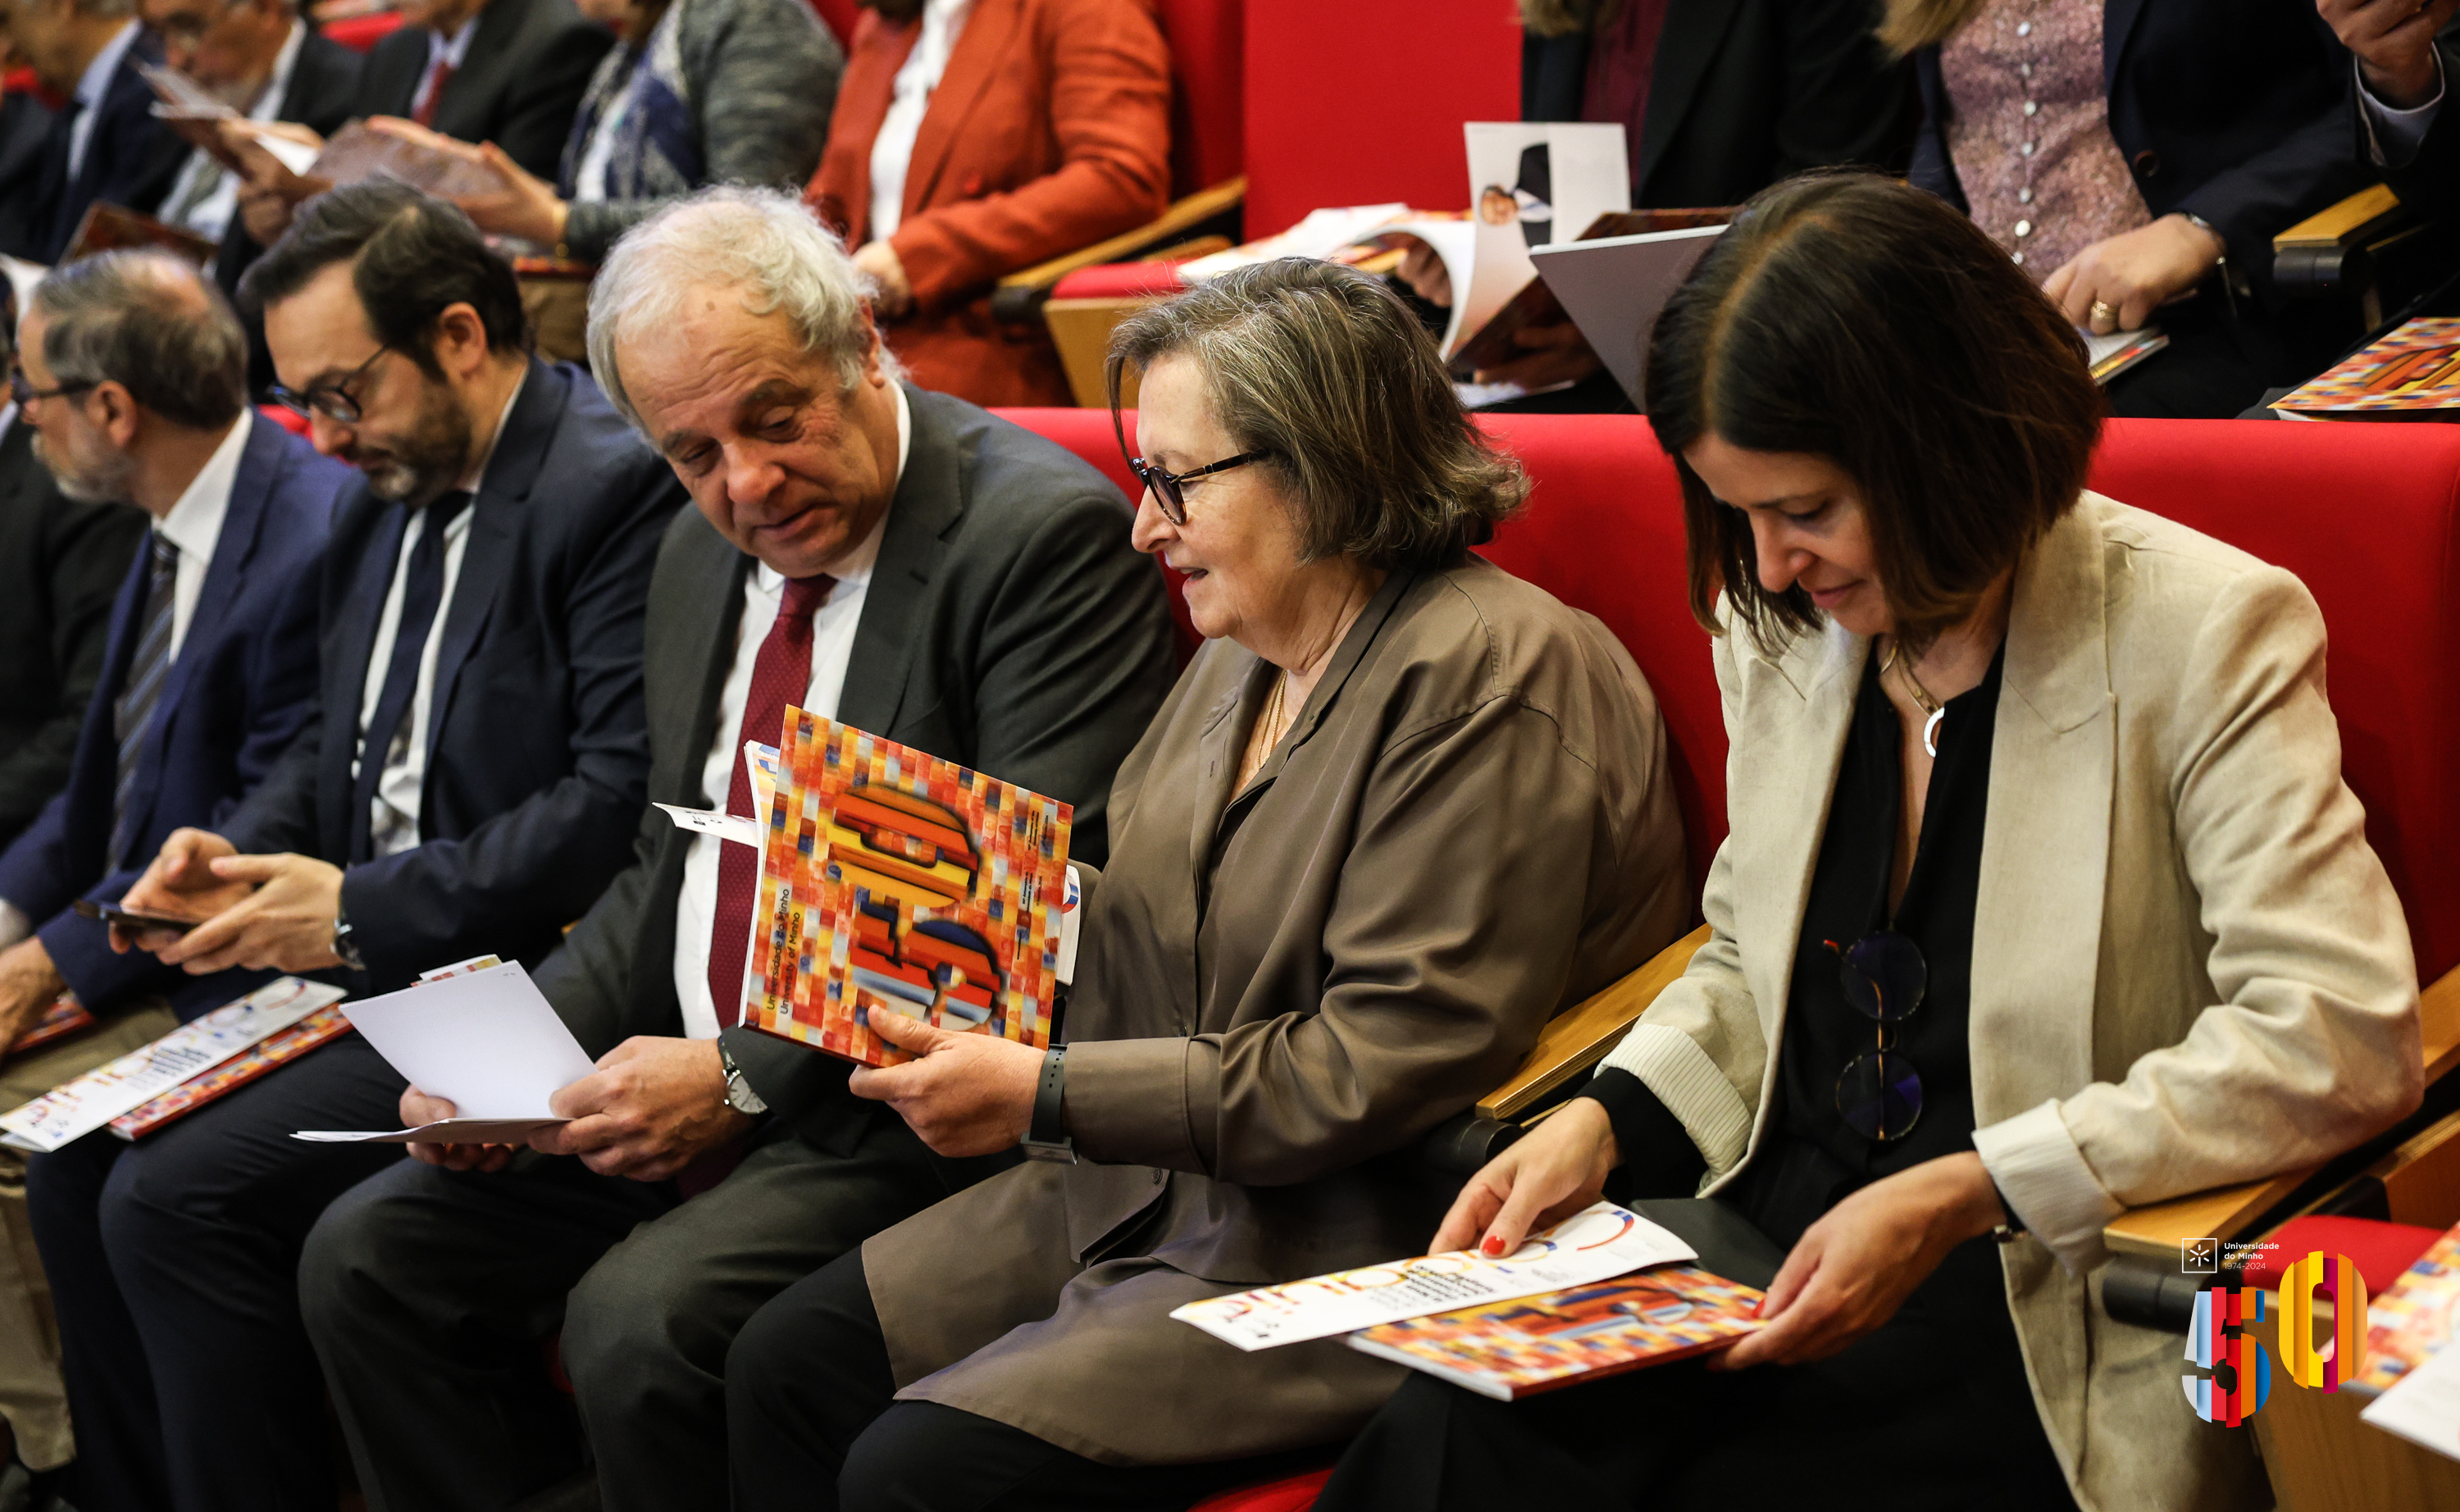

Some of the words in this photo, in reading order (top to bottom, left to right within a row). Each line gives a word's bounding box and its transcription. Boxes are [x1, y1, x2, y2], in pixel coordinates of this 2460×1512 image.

[778, 888, 790, 922] Minho
[775, 924, 785, 940] do
[789, 912, 800, 945] Minho
[787, 946, 795, 959] of
[766, 940, 783, 1010] Universidade
[780, 961, 795, 1015] University
